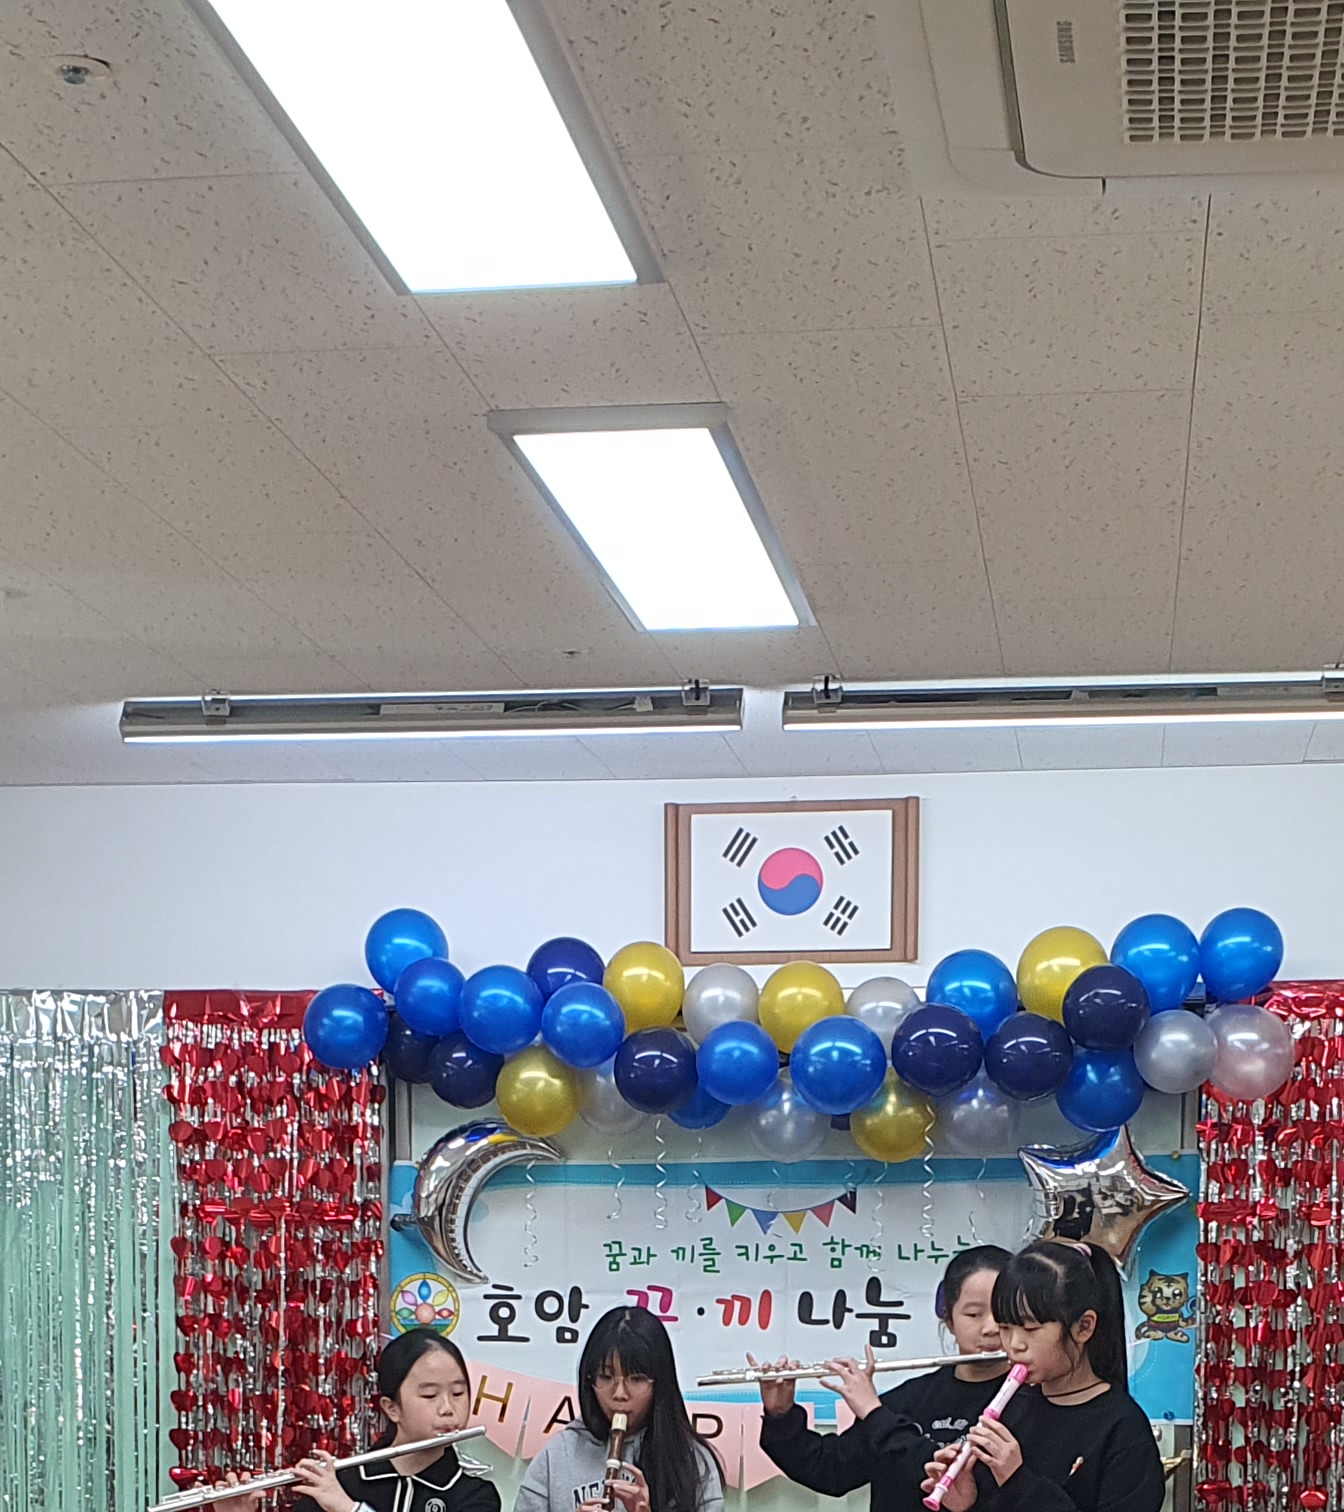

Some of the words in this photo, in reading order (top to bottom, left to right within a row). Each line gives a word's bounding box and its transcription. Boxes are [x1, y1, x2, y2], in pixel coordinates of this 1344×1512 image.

[603, 1241, 657, 1272] 꿈과
[670, 1237, 722, 1273] 끼를
[735, 1242, 808, 1264] 키우고
[822, 1235, 882, 1269] 함께
[476, 1283, 590, 1344] 호암
[798, 1276, 912, 1348] 나눔
